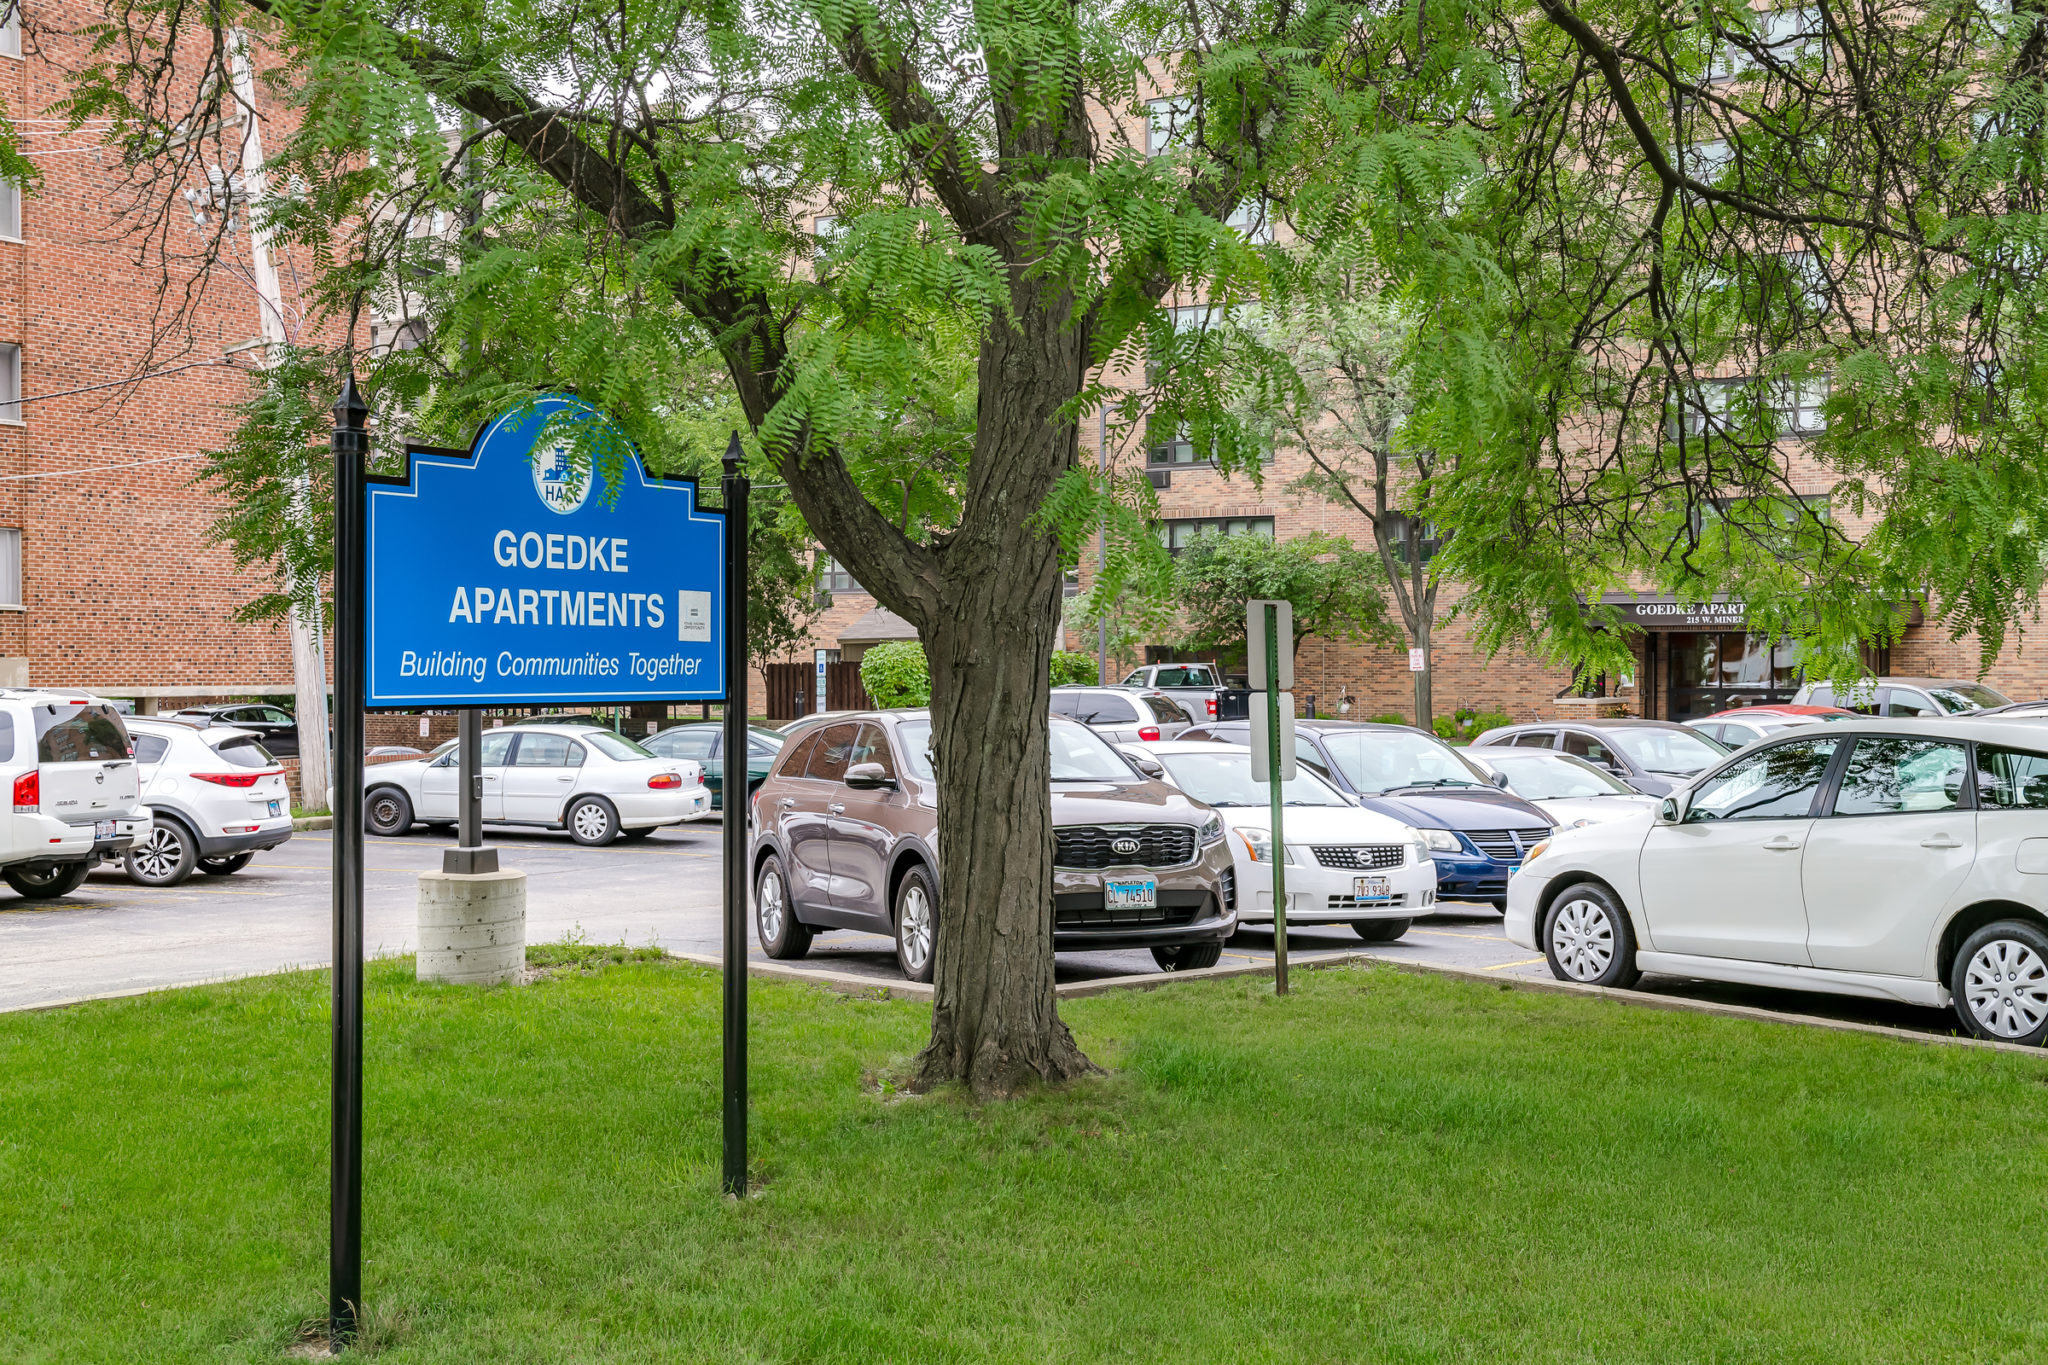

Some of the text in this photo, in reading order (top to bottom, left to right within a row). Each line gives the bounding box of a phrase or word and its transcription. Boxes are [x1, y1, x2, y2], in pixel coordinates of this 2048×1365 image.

[545, 485, 582, 504] HAC
[493, 529, 629, 573] GOEDKE
[448, 586, 665, 629] APARTMENTS
[1635, 604, 1696, 615] GOEDKE
[1686, 616, 1700, 624] 215
[1701, 616, 1713, 624] W.
[400, 650, 702, 682] Building Communities Together
[1116, 841, 1136, 851] KIA
[1107, 888, 1153, 904] CL 74510
